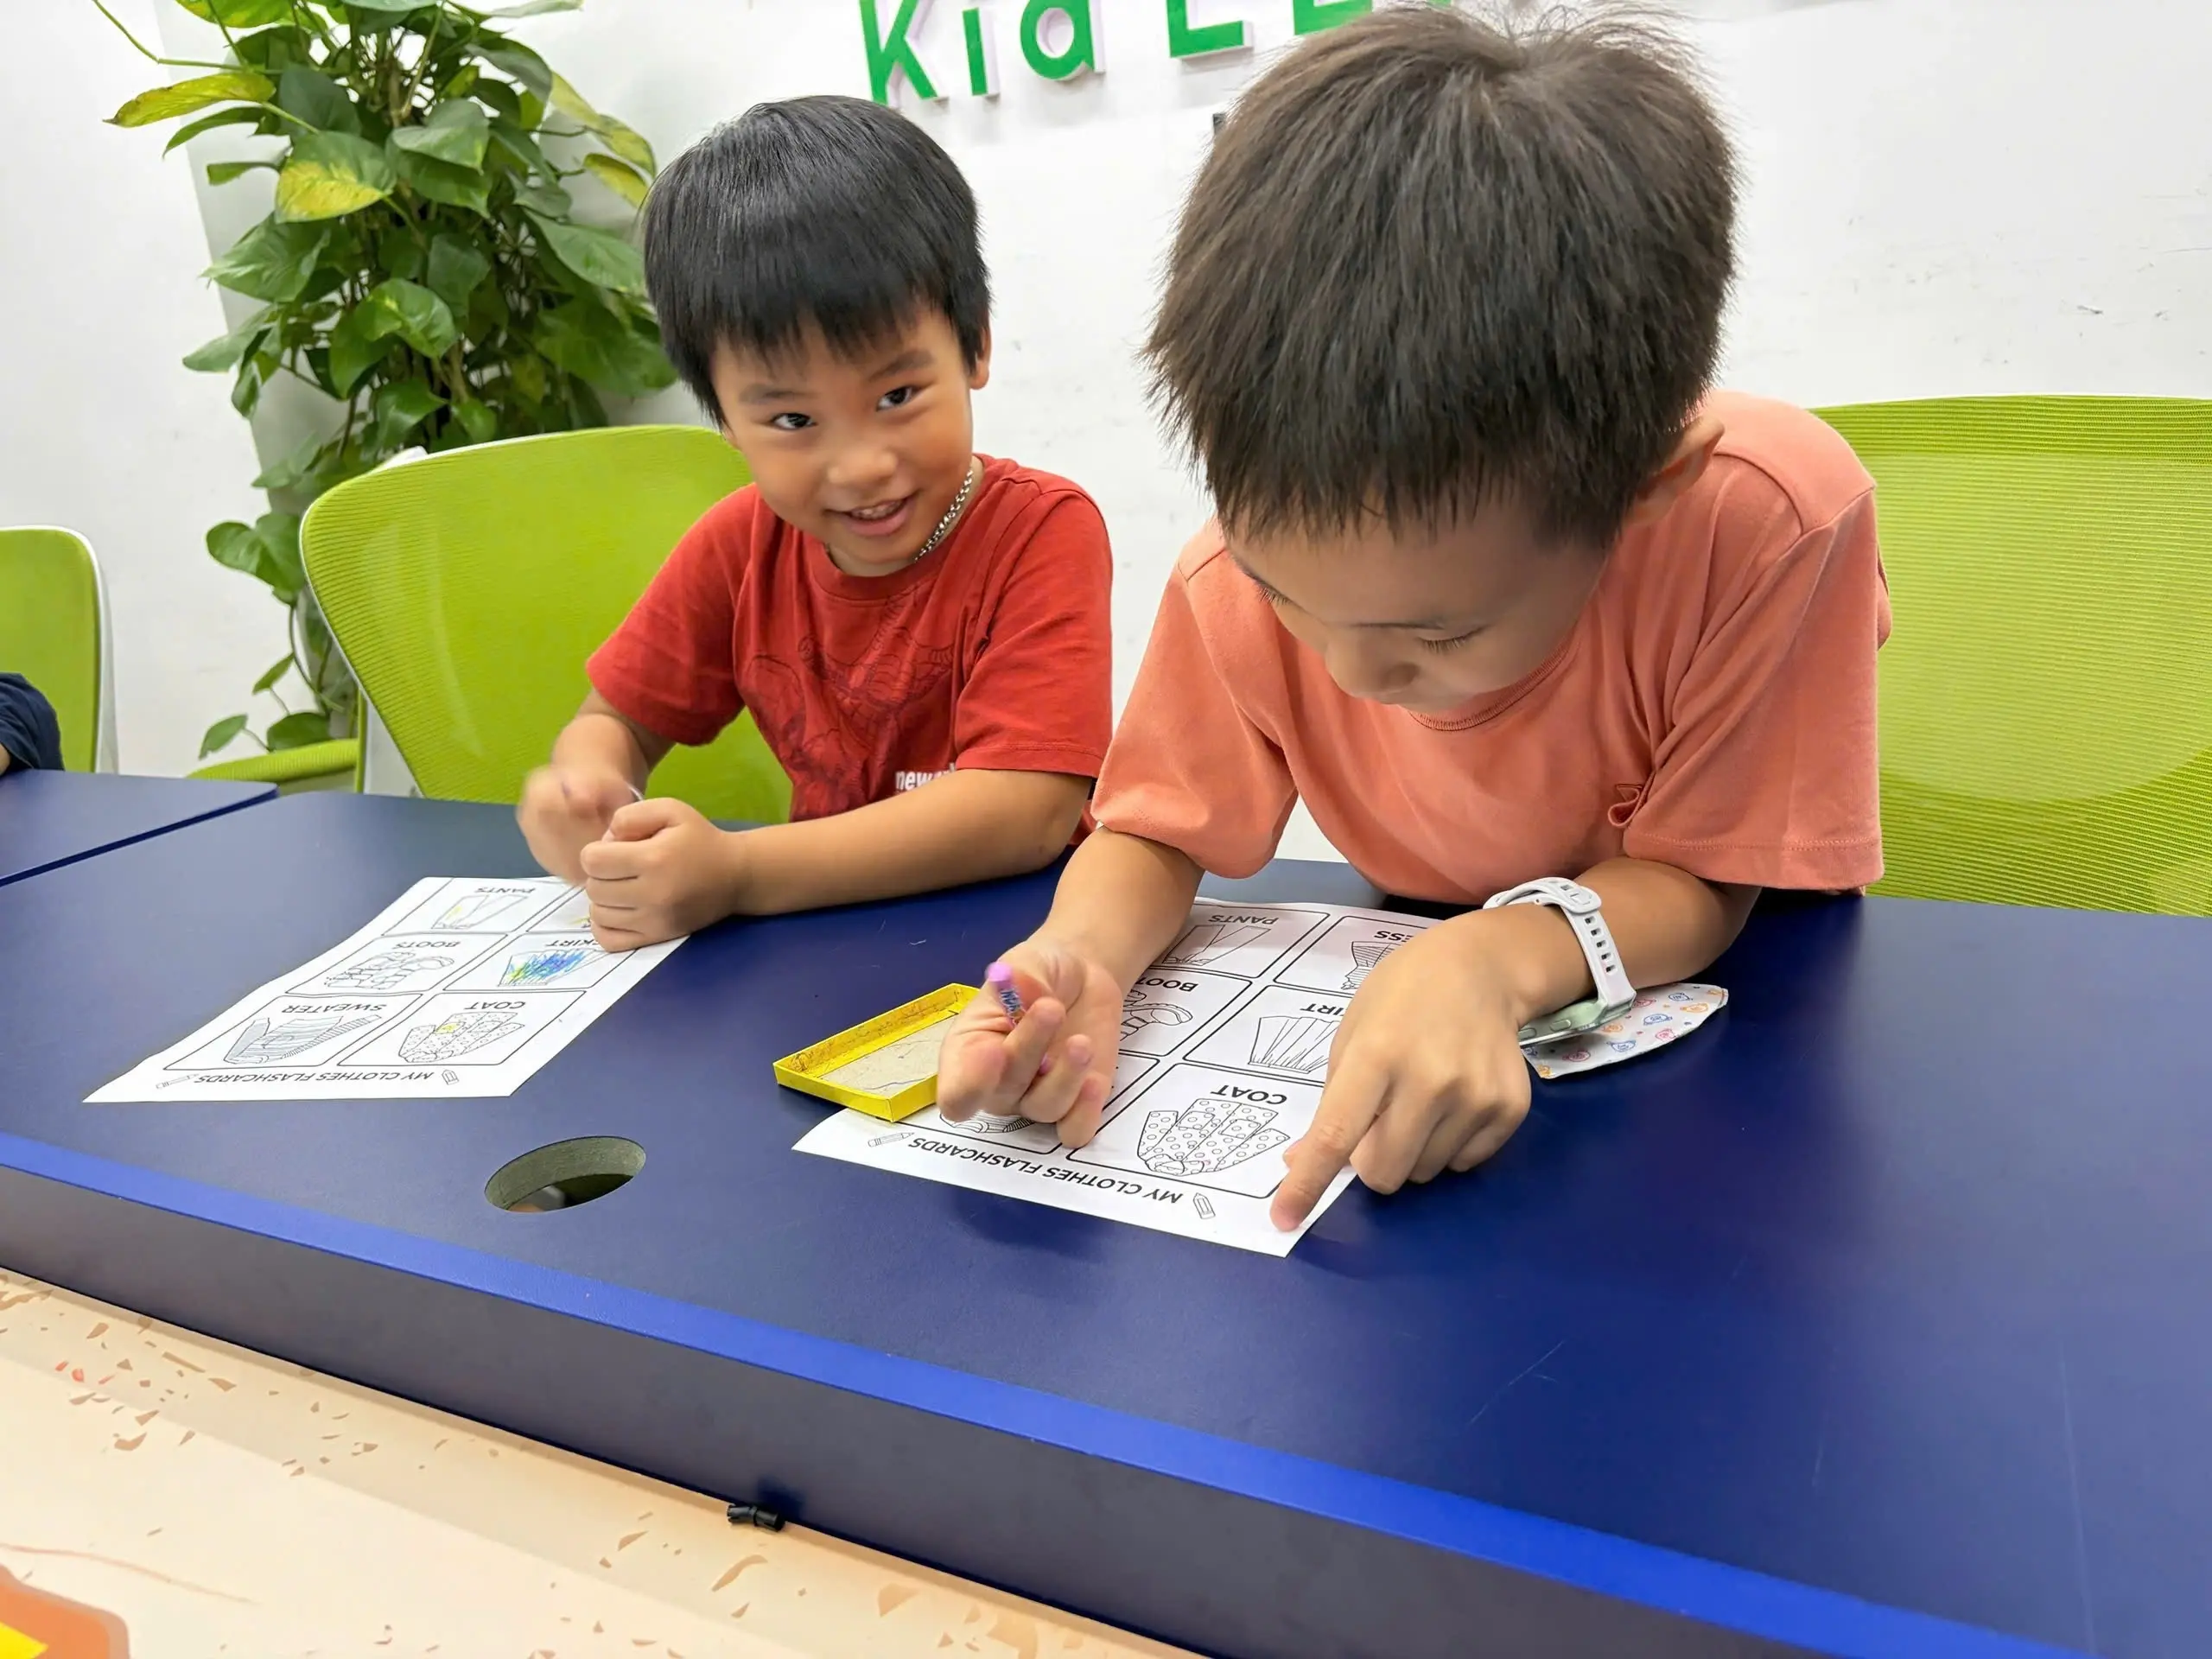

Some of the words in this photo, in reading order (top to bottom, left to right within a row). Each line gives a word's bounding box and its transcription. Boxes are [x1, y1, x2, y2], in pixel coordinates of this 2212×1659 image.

[1208, 913, 1279, 925] PANTS
[392, 940, 461, 949] BOOTS
[545, 938, 600, 948] KIRT
[1135, 977, 1199, 992] BOOT
[282, 1002, 388, 1014] SWEATER
[463, 1001, 526, 1010] COAT
[1300, 1002, 1344, 1017] IRT
[194, 1071, 315, 1084] FLASHCARDS
[316, 1071, 399, 1083] CLOTHES
[400, 1071, 435, 1082] MY
[1211, 1084, 1287, 1105] COAT
[908, 1137, 1040, 1176] FLASHCARDS
[1042, 1165, 1144, 1196] CLOTHES
[1145, 1187, 1184, 1205] MY
